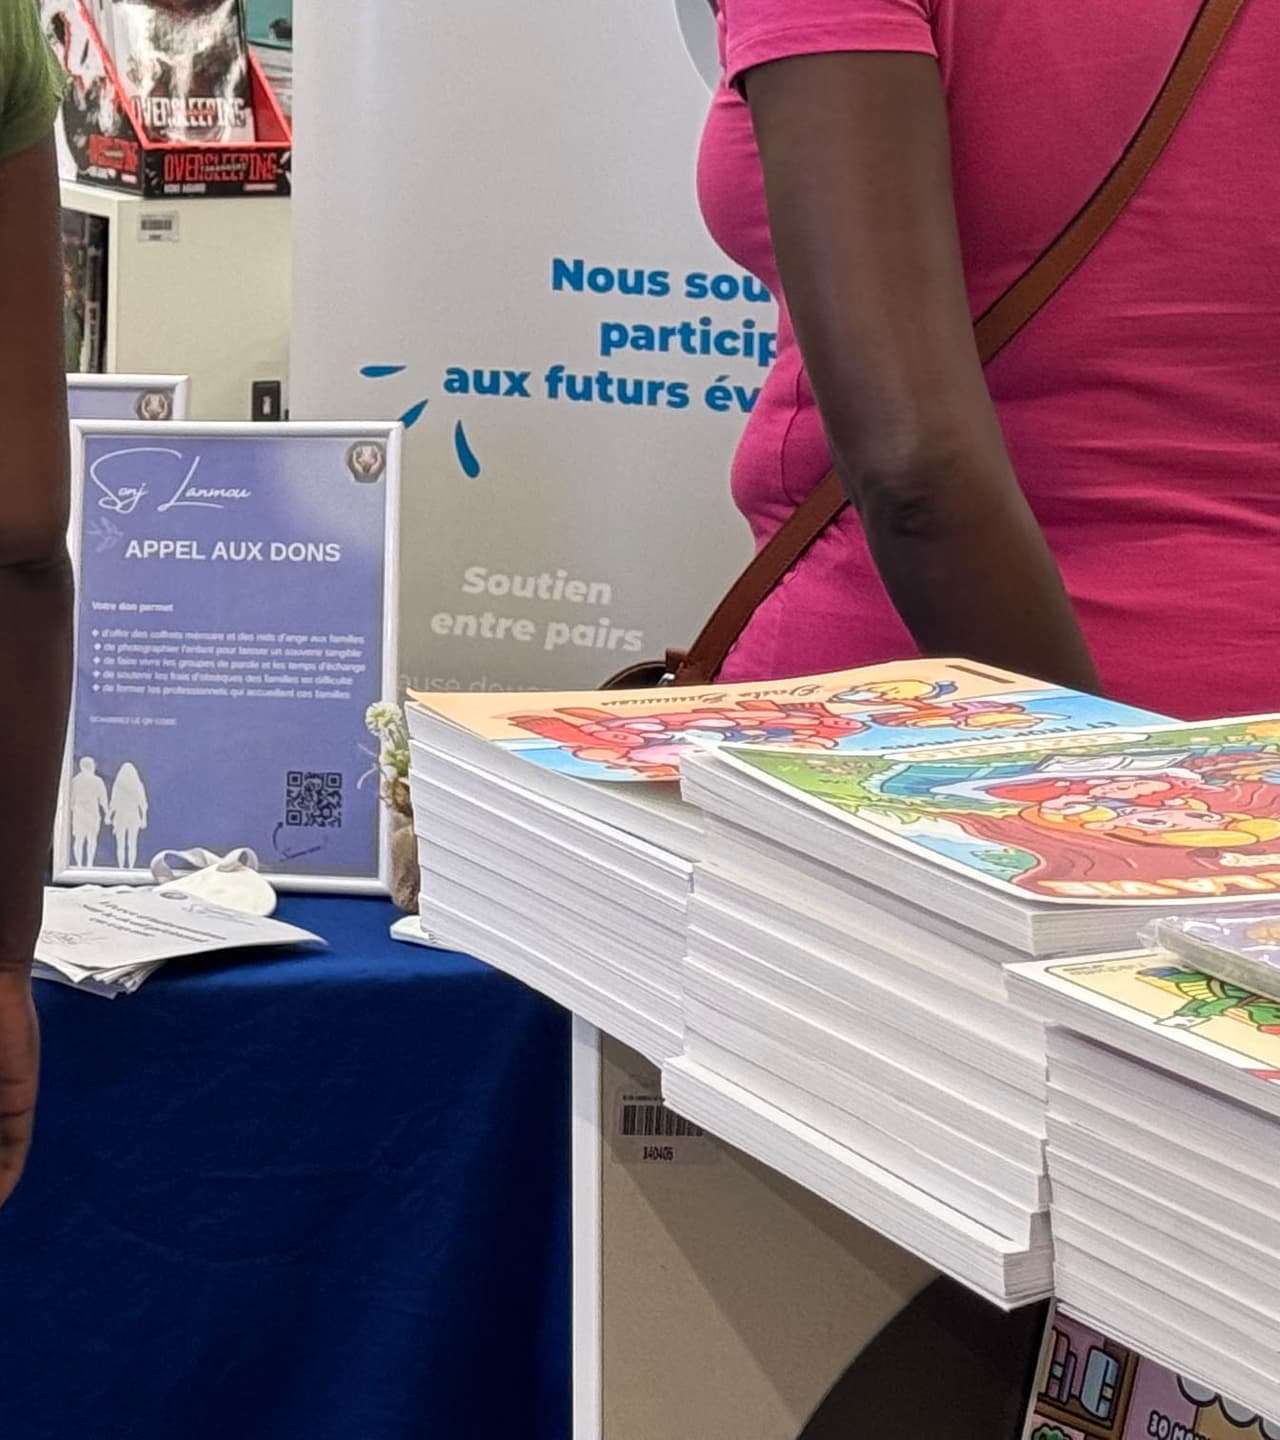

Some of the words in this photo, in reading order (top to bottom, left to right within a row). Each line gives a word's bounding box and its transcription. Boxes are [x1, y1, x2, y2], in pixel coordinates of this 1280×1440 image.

[552, 258, 670, 297] Nous
[442, 366, 532, 398] aux
[545, 365, 690, 409] futurs
[124, 539, 205, 559] APPEL
[211, 541, 263, 561] AUX
[270, 542, 341, 562] DONS
[461, 566, 612, 605] Soutien
[431, 611, 537, 641] entre
[543, 617, 643, 651] pairs
